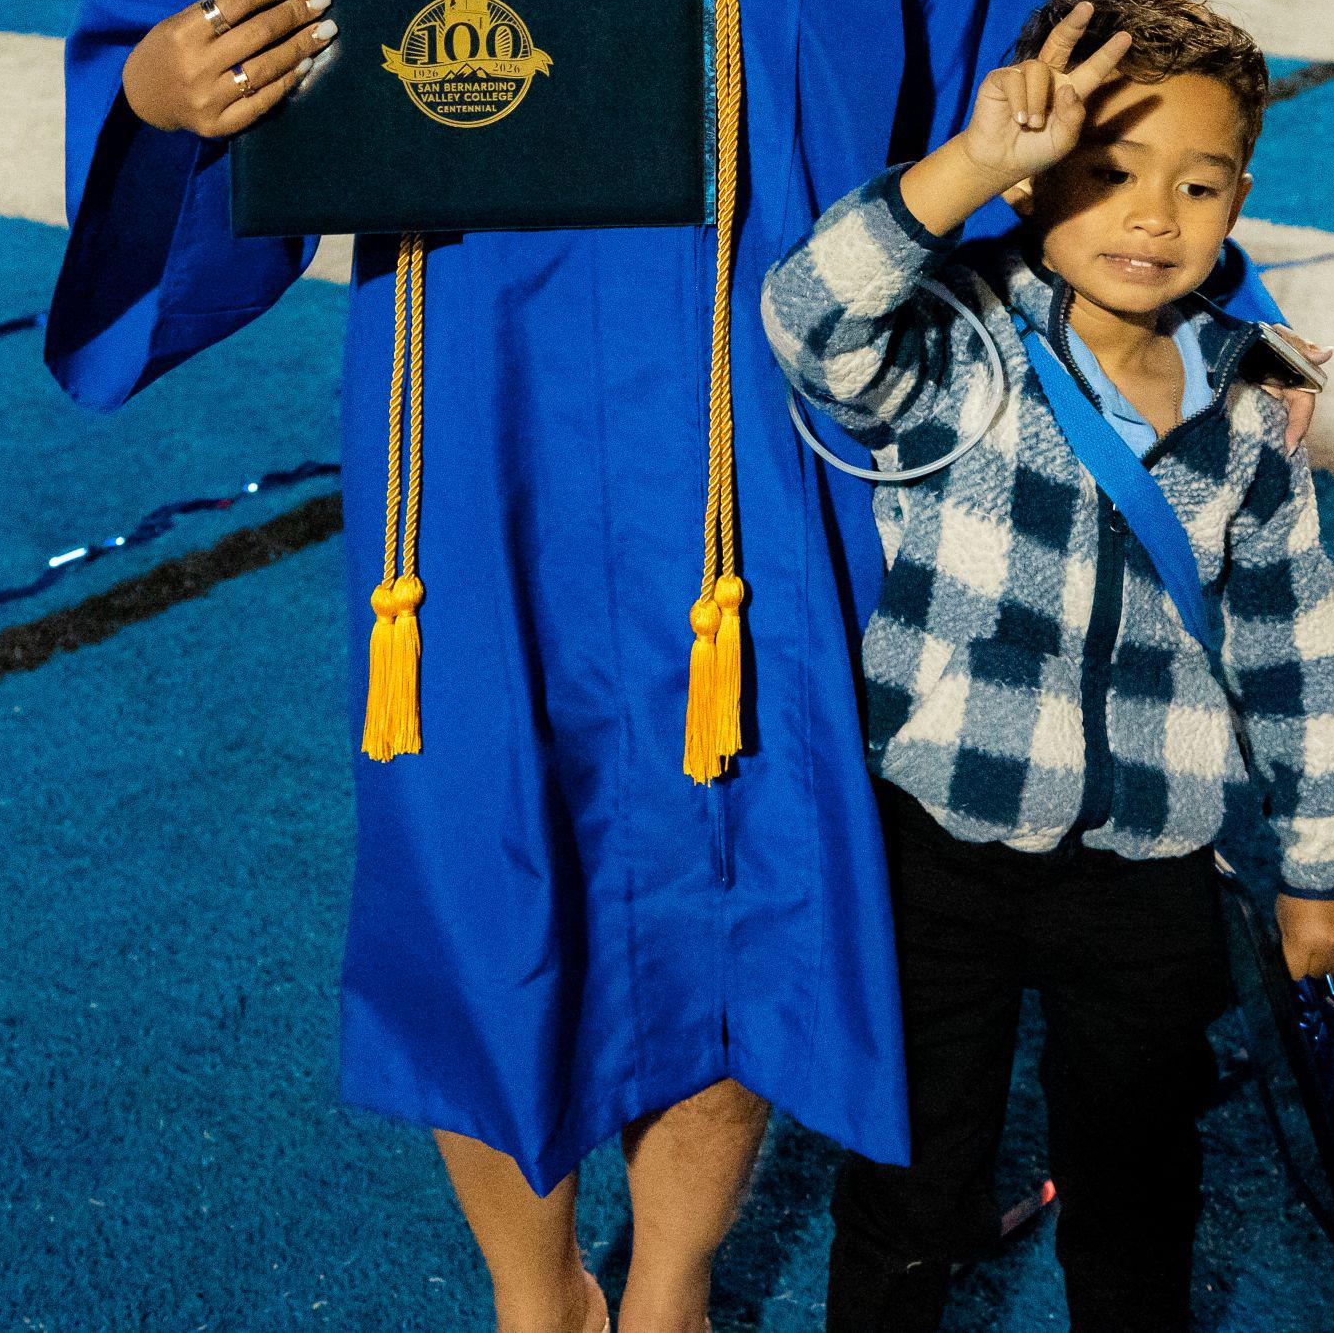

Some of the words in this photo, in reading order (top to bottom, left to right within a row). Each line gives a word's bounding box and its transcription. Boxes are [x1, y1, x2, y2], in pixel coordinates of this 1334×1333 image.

[415, 22, 522, 65] 100
[413, 69, 439, 78] 1926
[493, 62, 521, 74] 2026
[418, 84, 439, 93] SAN
[444, 81, 516, 92] BERNARDINO
[421, 93, 460, 102] VALLEY
[464, 92, 513, 102] COLLEGE
[437, 104, 497, 113] CENTENNIAL
